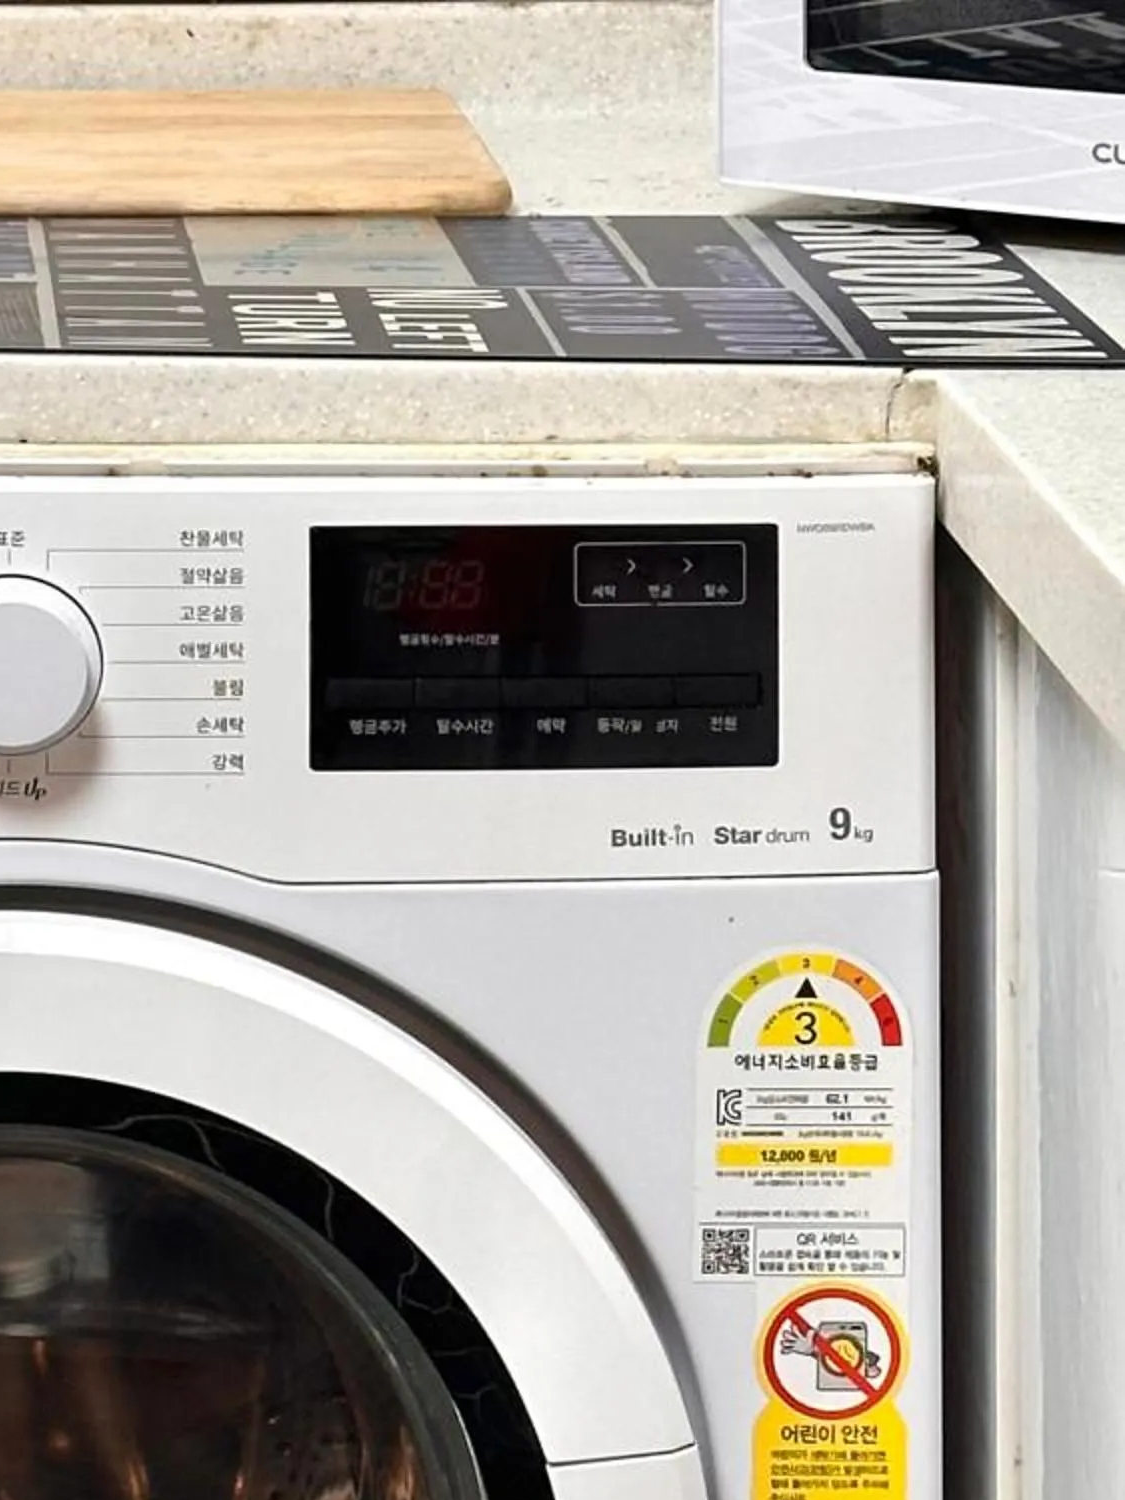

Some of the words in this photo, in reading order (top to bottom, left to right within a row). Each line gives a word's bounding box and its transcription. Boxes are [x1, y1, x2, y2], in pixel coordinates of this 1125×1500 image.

[774, 219, 1107, 359] BROOKLYN
[179, 530, 244, 547] 찬물세탁
[179, 567, 244, 584] 절약삶음
[179, 605, 244, 622] 고온삶음
[179, 642, 245, 659] 애벌세탁
[213, 680, 244, 696] 불림
[196, 717, 245, 733] 손세탁
[349, 720, 408, 735] 헹굼추가
[436, 719, 495, 735] 탈수시간
[536, 718, 566, 734] 예약
[709, 716, 739, 733] 전원
[212, 754, 244, 771] 강력
[610, 823, 695, 848] Built-in
[713, 825, 761, 845] Star
[765, 829, 811, 845] drum
[793, 1011, 818, 1046] 3
[734, 1053, 879, 1072] 에너지소비효율등급
[821, 1232, 860, 1246] 서비스
[780, 1425, 835, 1444] 어린이
[841, 1425, 878, 1444] 안전
